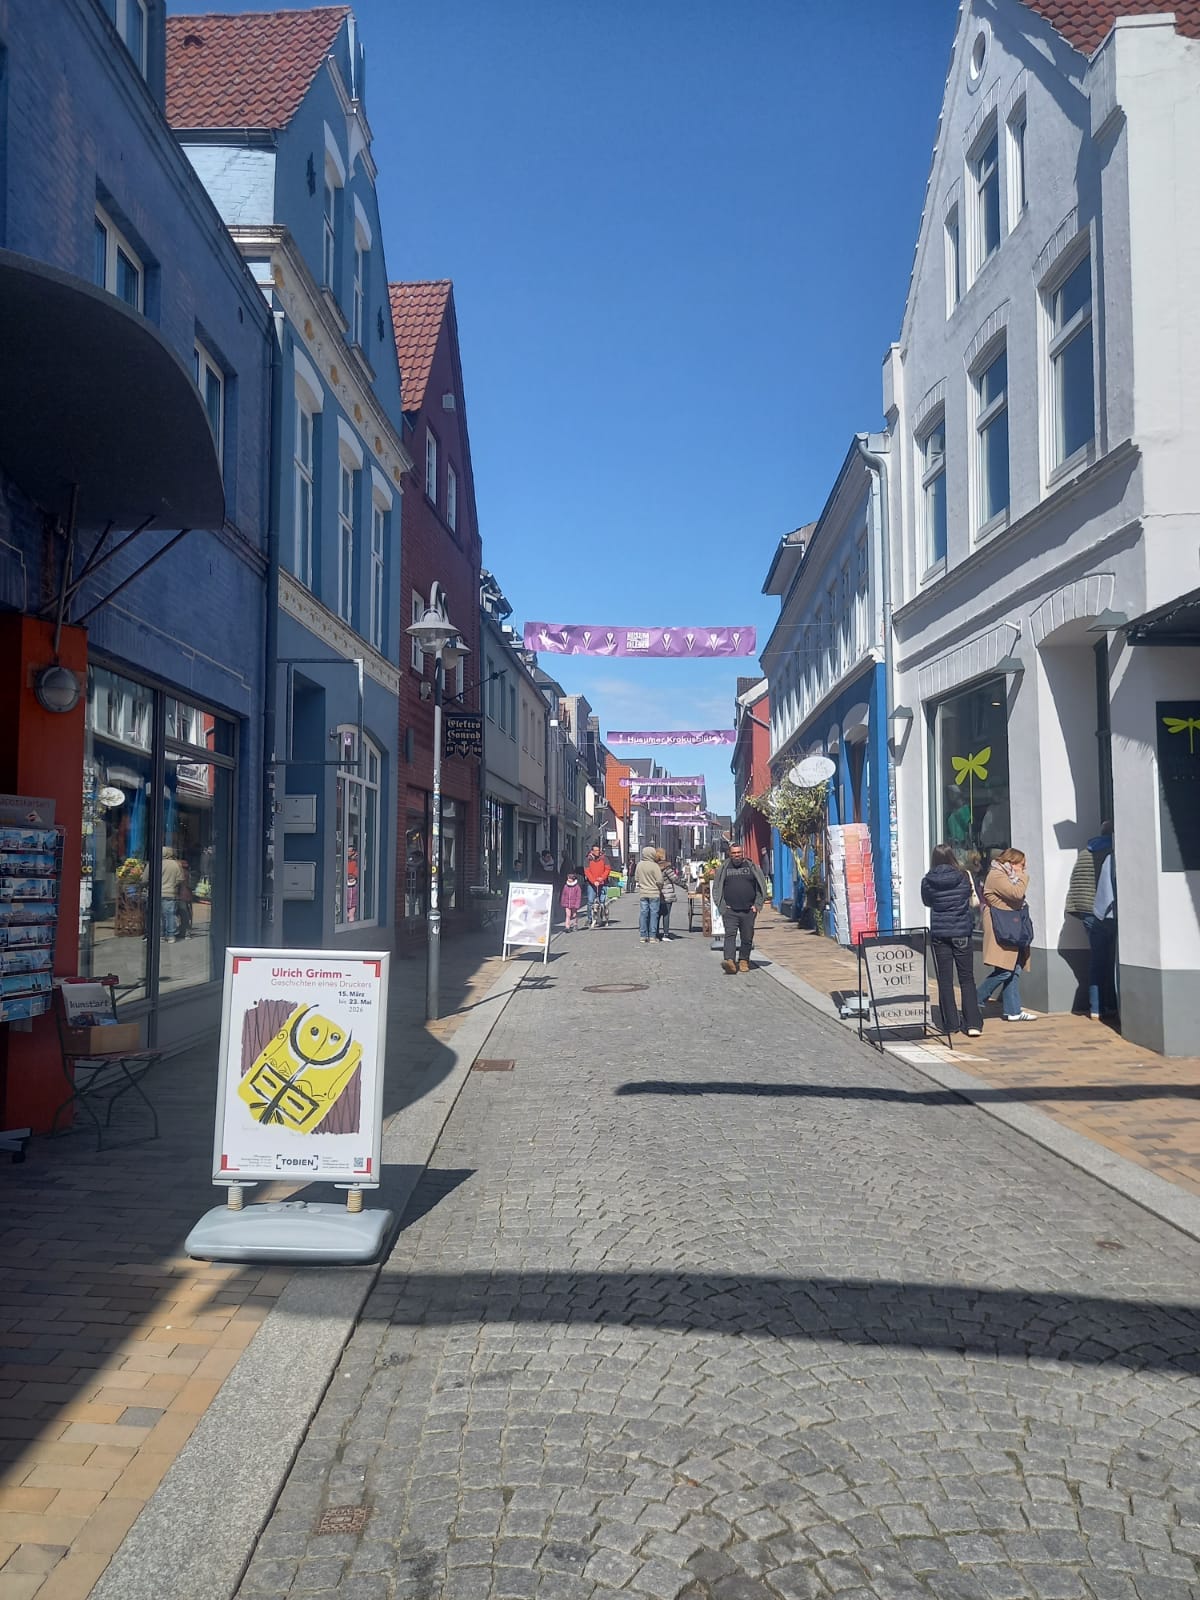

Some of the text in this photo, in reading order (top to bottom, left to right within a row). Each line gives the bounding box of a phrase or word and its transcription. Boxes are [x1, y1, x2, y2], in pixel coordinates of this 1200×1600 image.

[627, 736, 664, 744] Husumer
[876, 950, 914, 961] GOOD
[271, 967, 302, 978] Ulrich
[306, 968, 342, 979] Grimm
[877, 962, 916, 974] TO SEE
[271, 978, 372, 988] Geschichten eines Druckers
[883, 975, 911, 986] YOU!
[281, 1158, 314, 1166] TOBIEN
